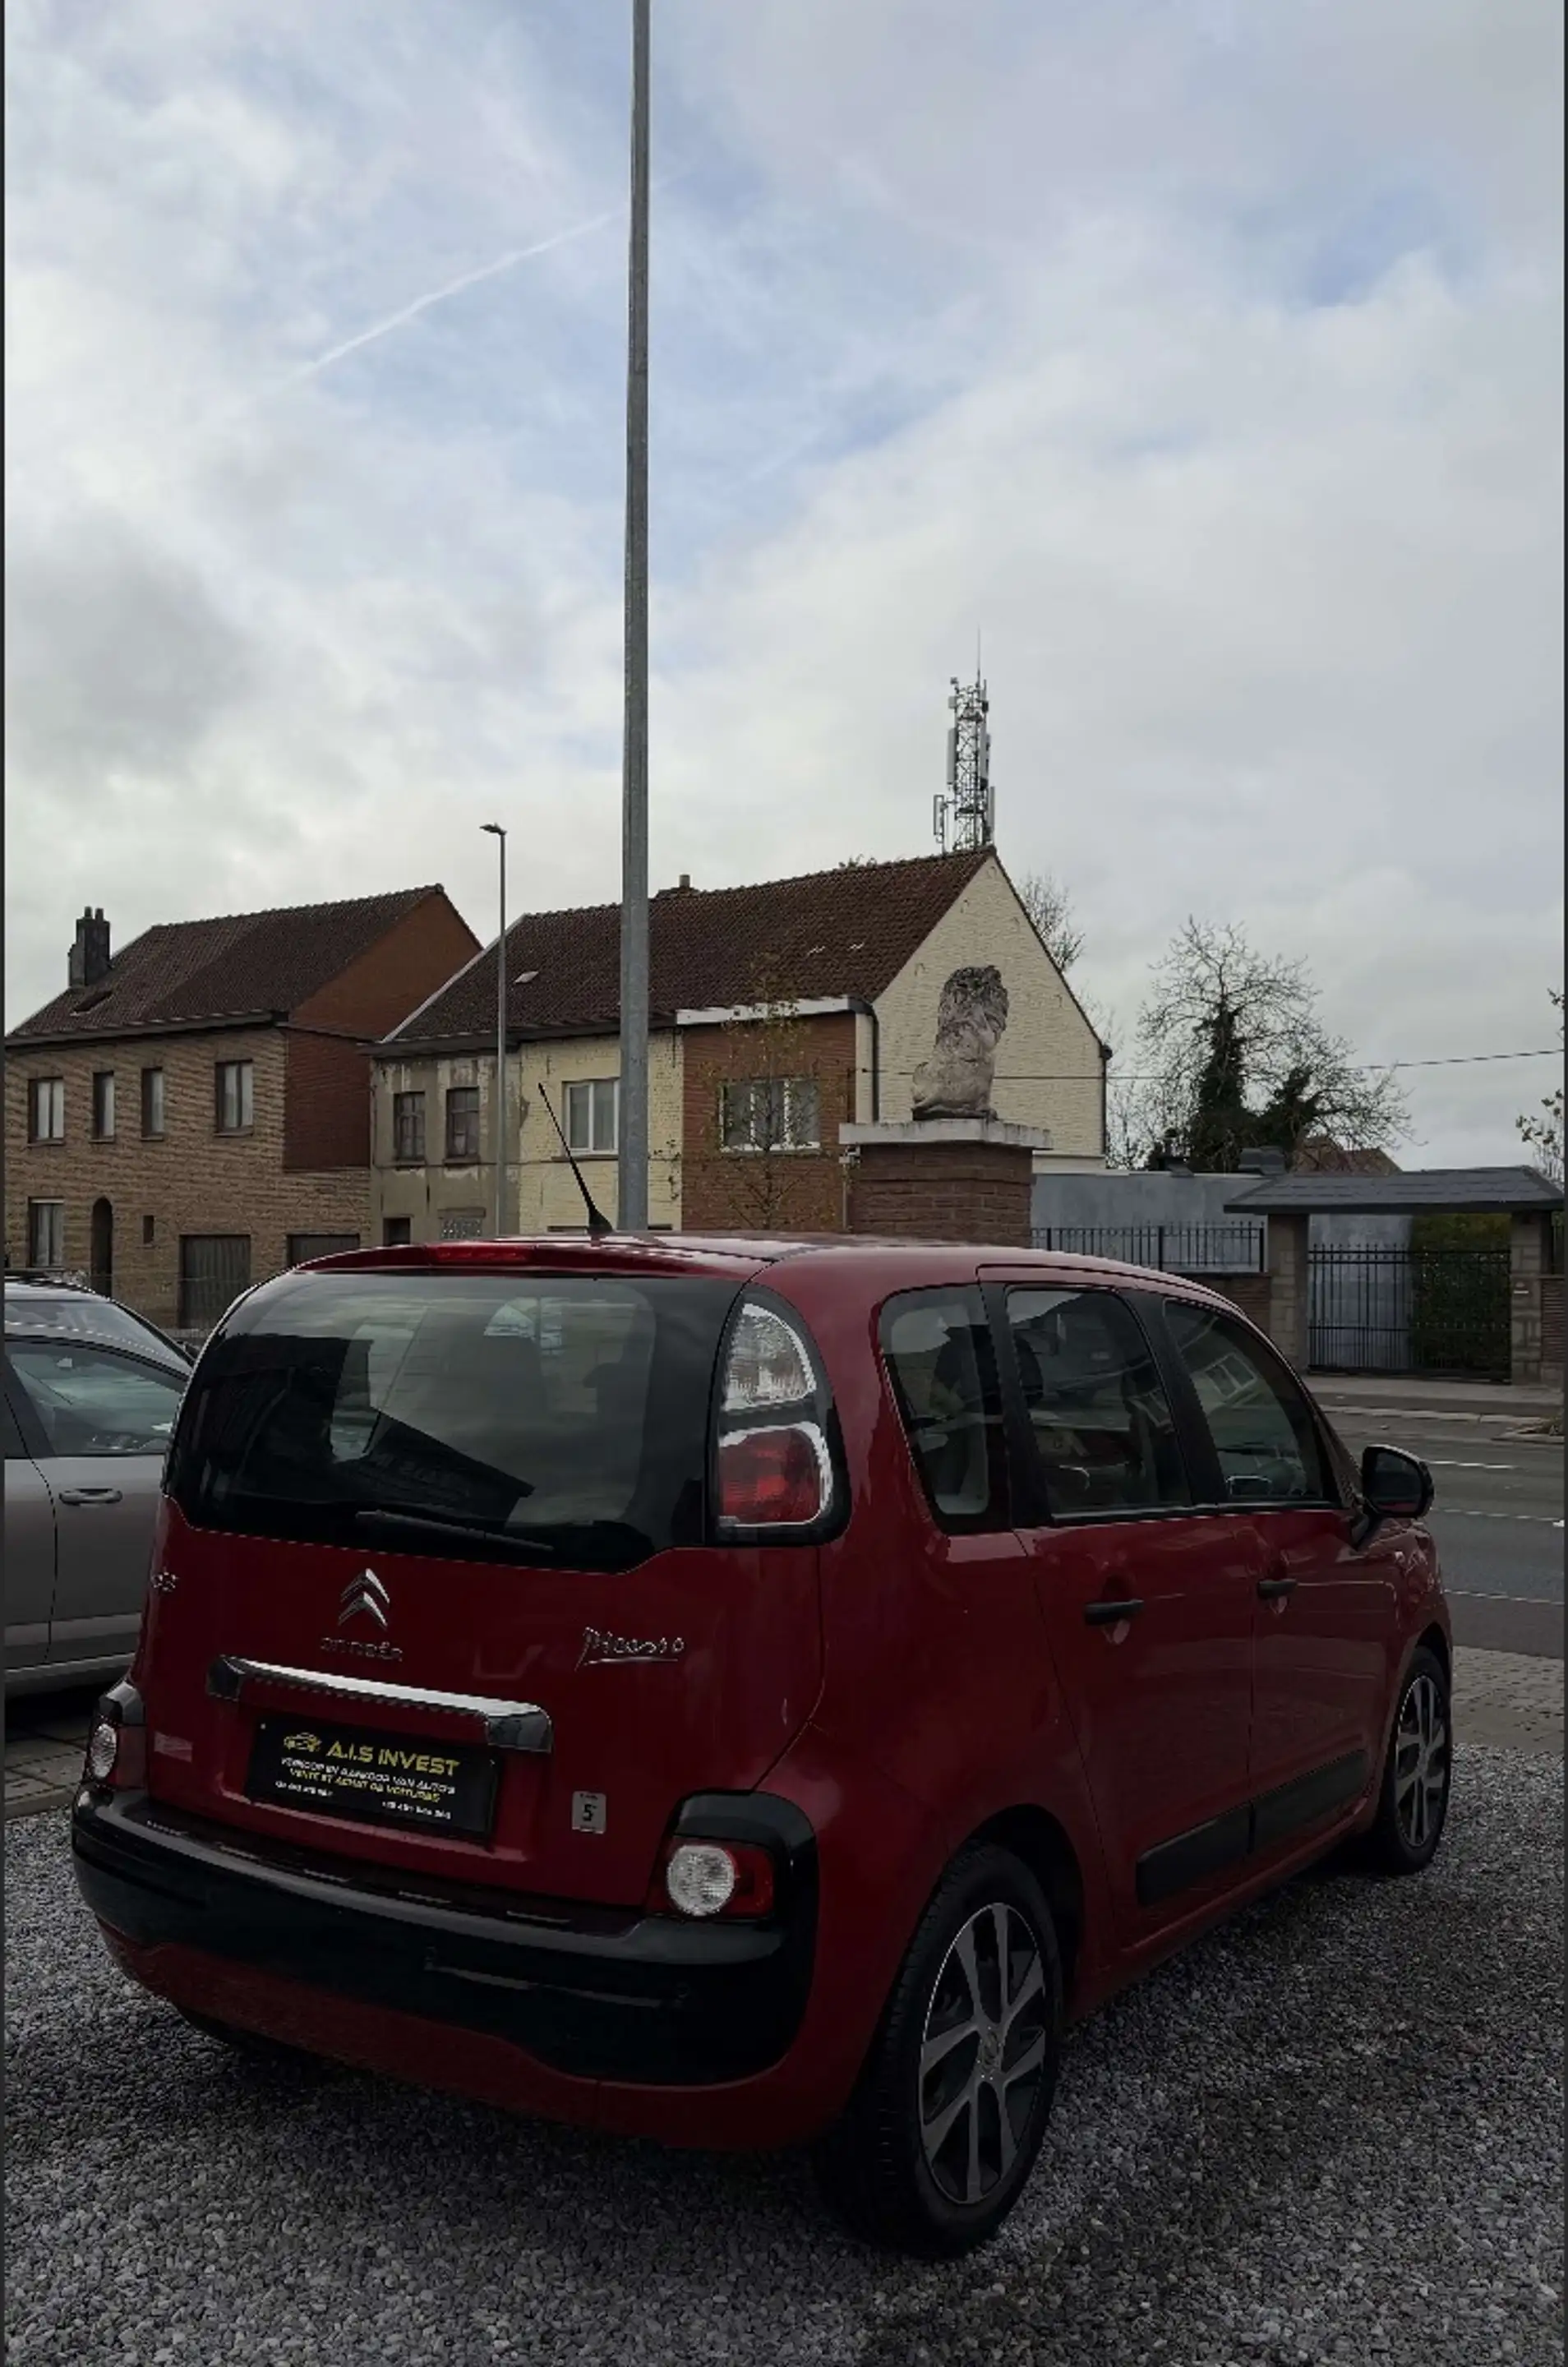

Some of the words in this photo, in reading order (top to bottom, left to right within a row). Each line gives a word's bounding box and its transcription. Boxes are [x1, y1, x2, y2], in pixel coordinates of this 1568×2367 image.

[326, 1741, 374, 1763] A.I.S
[378, 1748, 460, 1776] INVEST
[321, 1774, 333, 1783] ET
[335, 1776, 368, 1788] ACHAT
[393, 1776, 415, 1788] VAN
